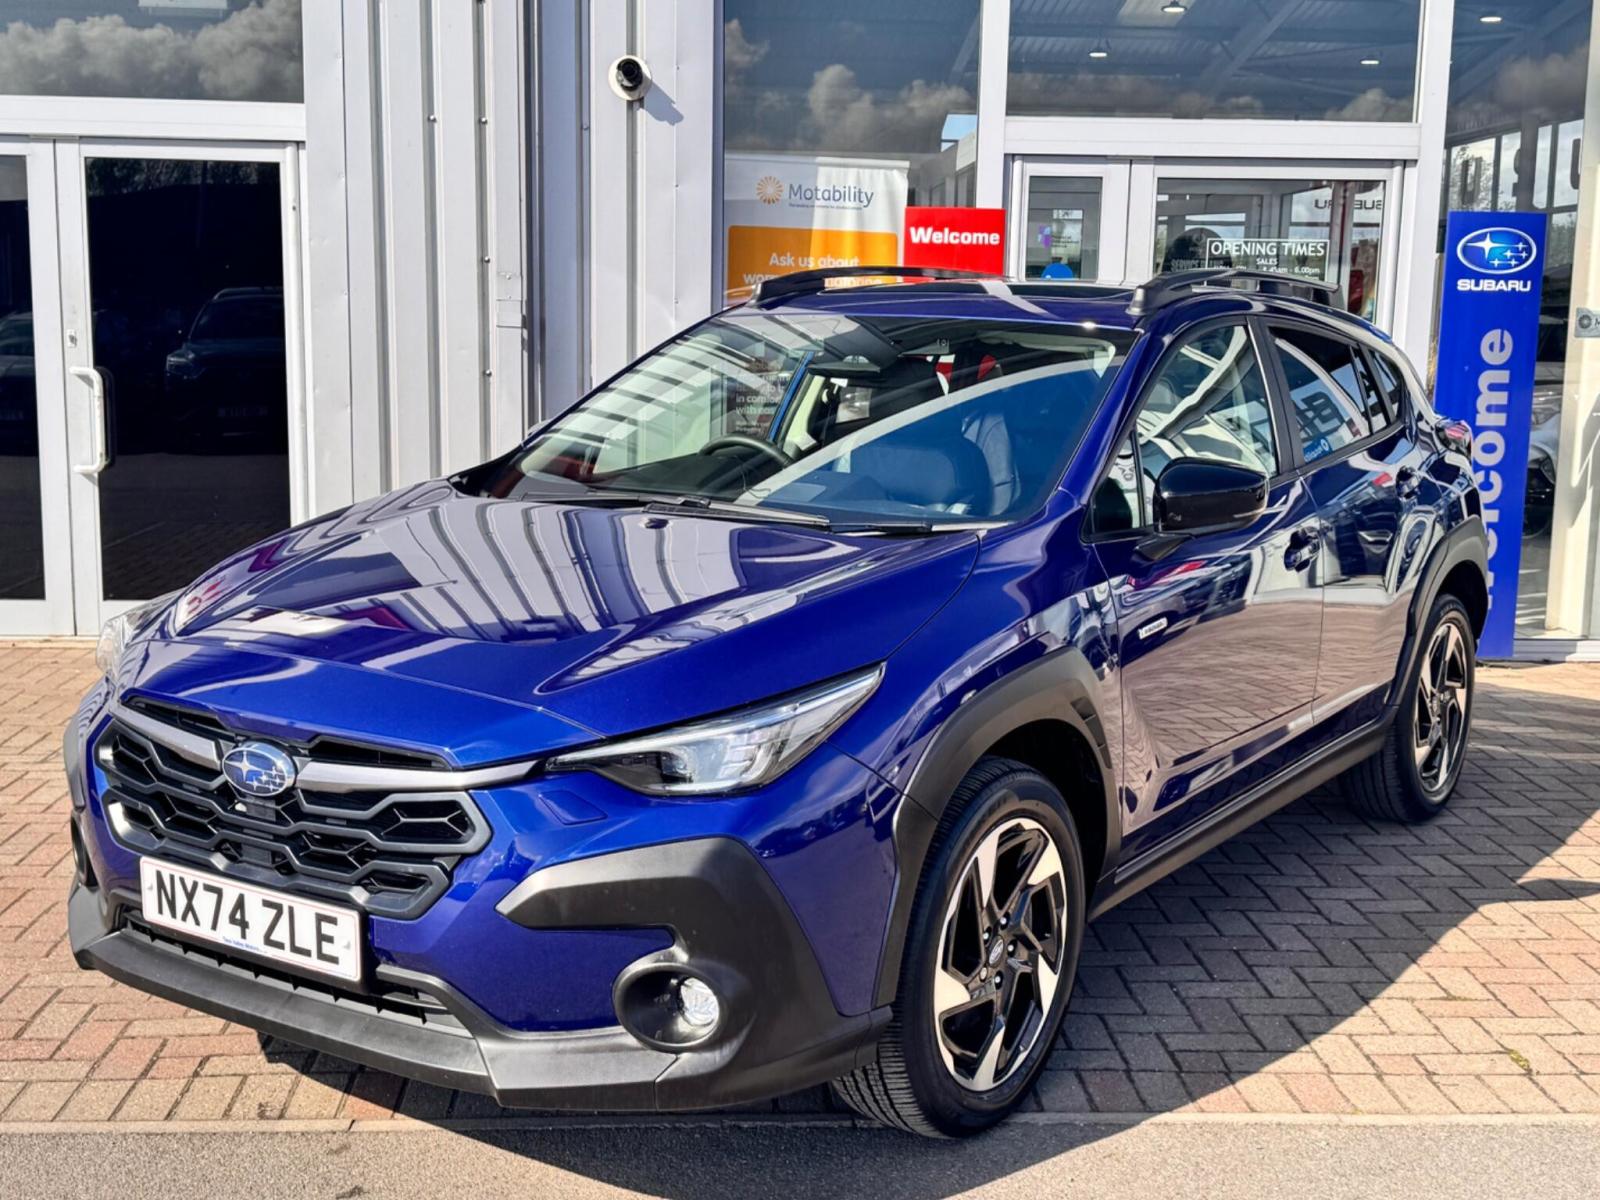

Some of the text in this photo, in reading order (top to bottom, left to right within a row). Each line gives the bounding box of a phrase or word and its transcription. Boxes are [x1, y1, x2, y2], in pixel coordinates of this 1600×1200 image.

[788, 183, 874, 208] Motability
[909, 226, 1000, 246] Welcome
[1210, 242, 1325, 256] OPENING TIMES
[769, 252, 860, 268] Ask us about
[1456, 279, 1532, 292] SUBARU
[155, 869, 340, 966] NX74 ZLE
